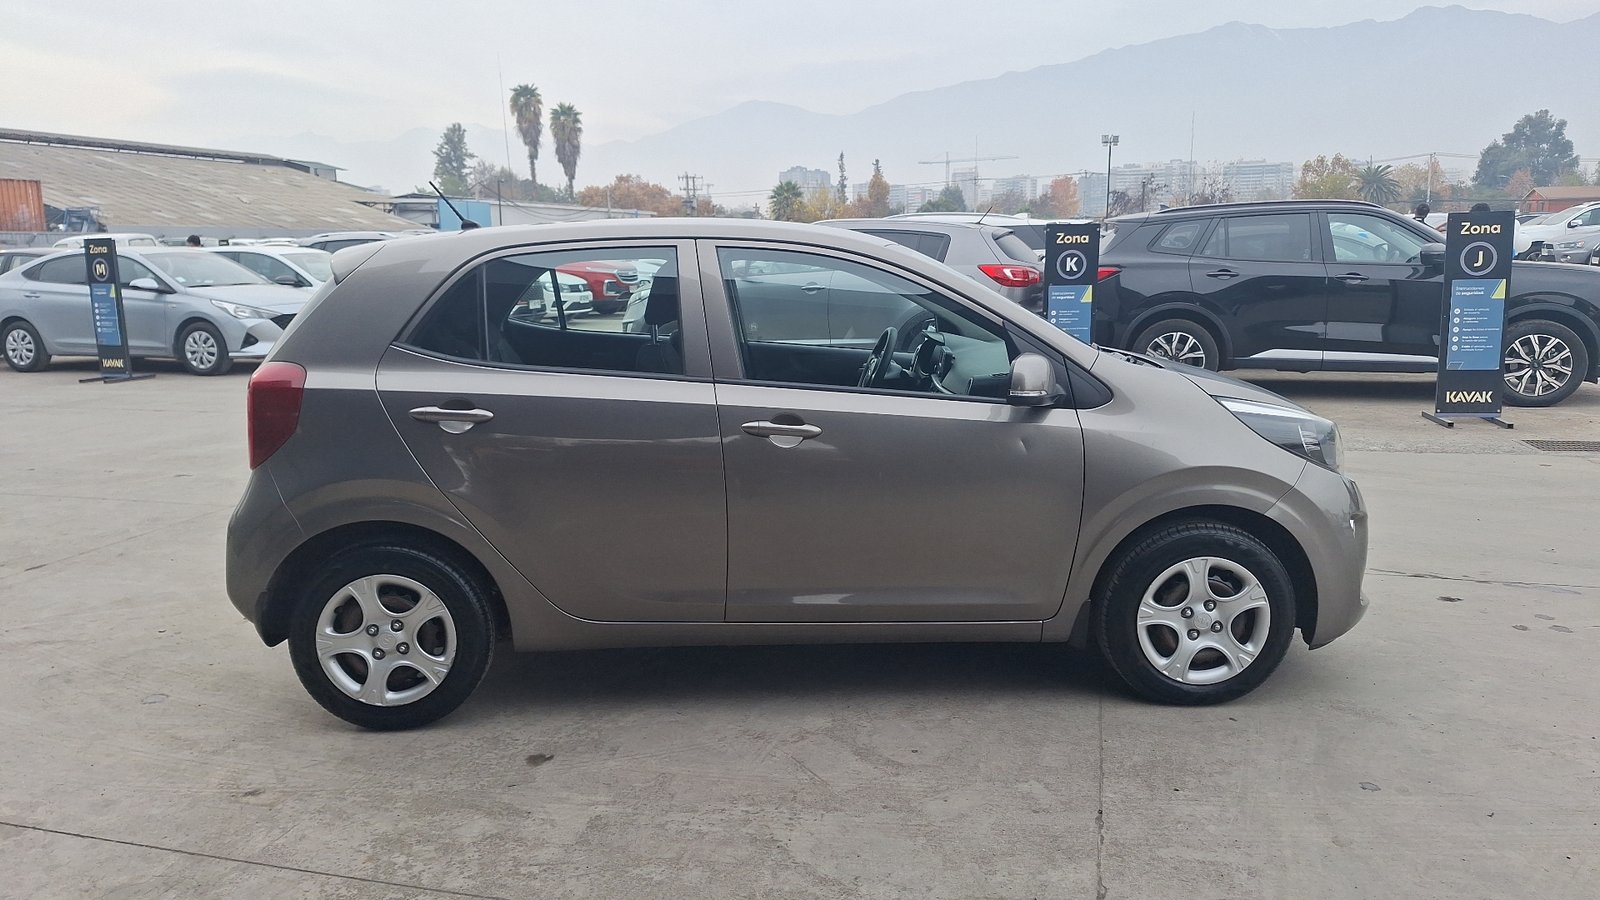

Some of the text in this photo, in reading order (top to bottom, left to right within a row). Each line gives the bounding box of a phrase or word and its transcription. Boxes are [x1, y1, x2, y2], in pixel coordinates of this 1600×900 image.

[1460, 222, 1501, 235] Zona
[1056, 233, 1089, 244] Zona
[89, 245, 108, 254] Zona
[1066, 257, 1078, 272] K
[1474, 251, 1484, 267] J
[95, 264, 106, 276] M
[1445, 391, 1493, 404] KAVAK
